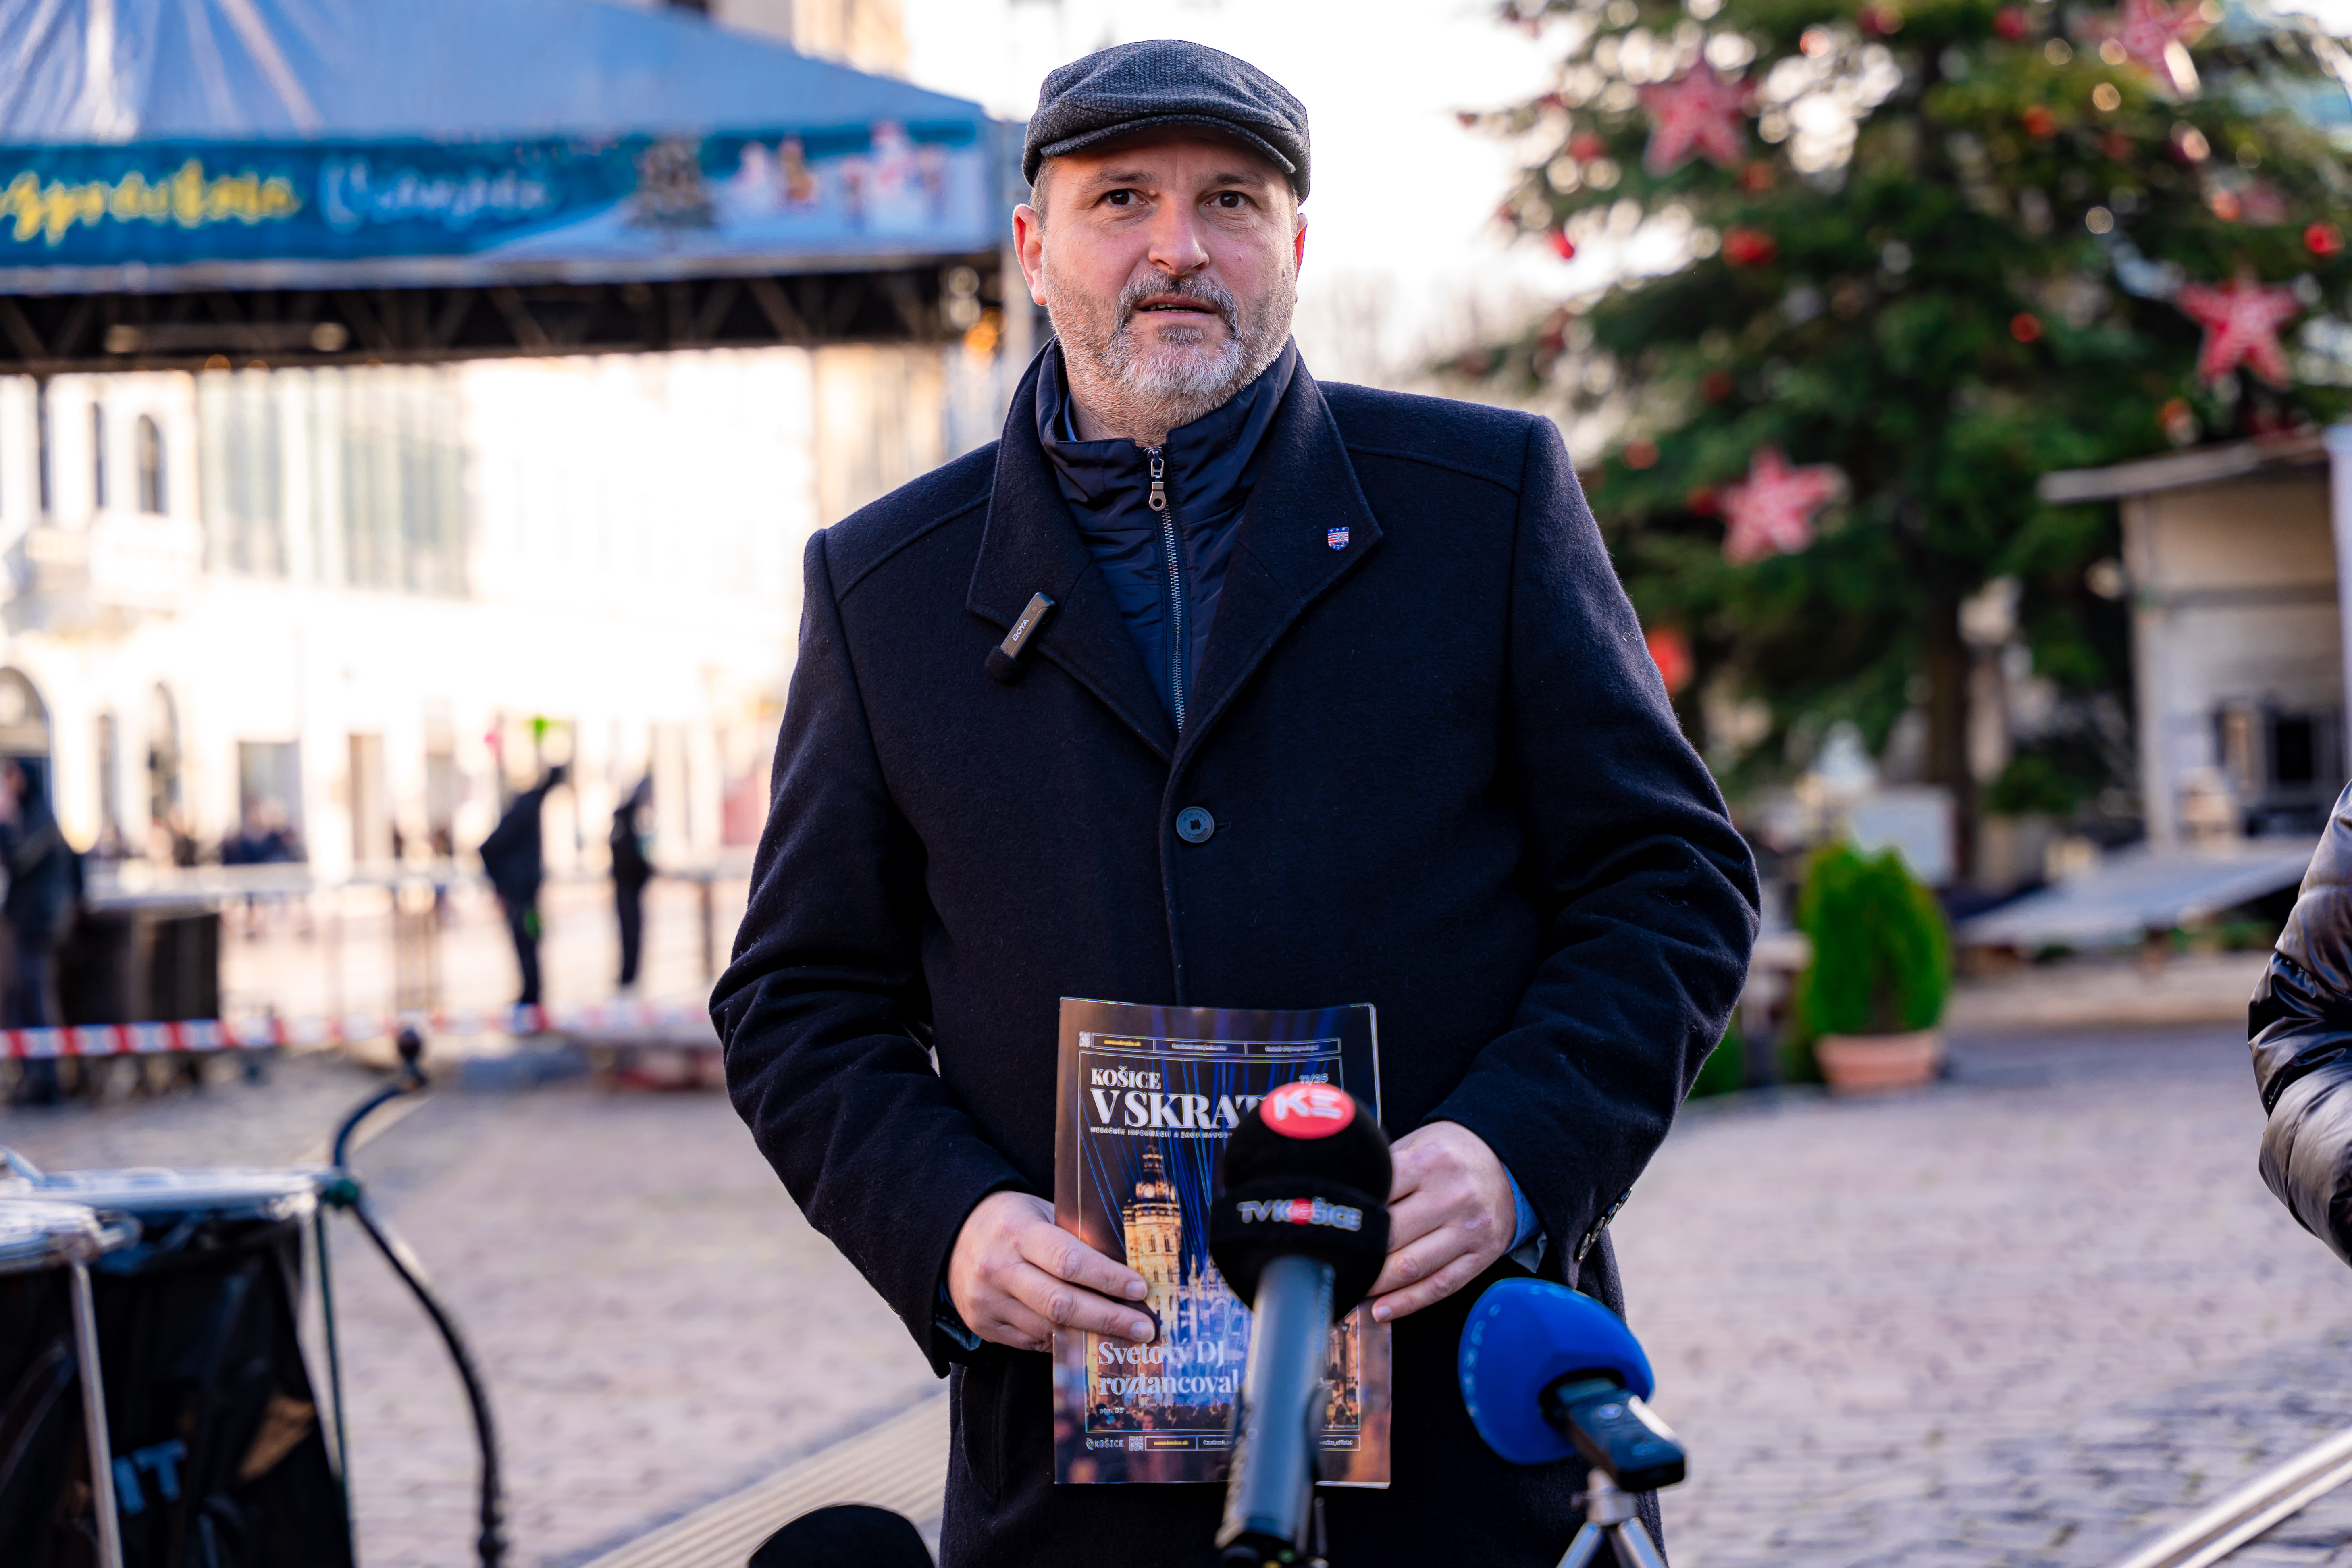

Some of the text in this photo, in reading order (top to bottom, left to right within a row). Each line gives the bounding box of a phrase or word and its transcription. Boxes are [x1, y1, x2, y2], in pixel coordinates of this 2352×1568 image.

[1012, 619, 1029, 641] BOYA
[1091, 1065, 1161, 1089] KOŠICE
[1299, 1073, 1329, 1087] 11/25
[1090, 1088, 1120, 1124] V
[1099, 1337, 1225, 1369] Svetový DJ
[1094, 1437, 1124, 1448] KOŠICE
